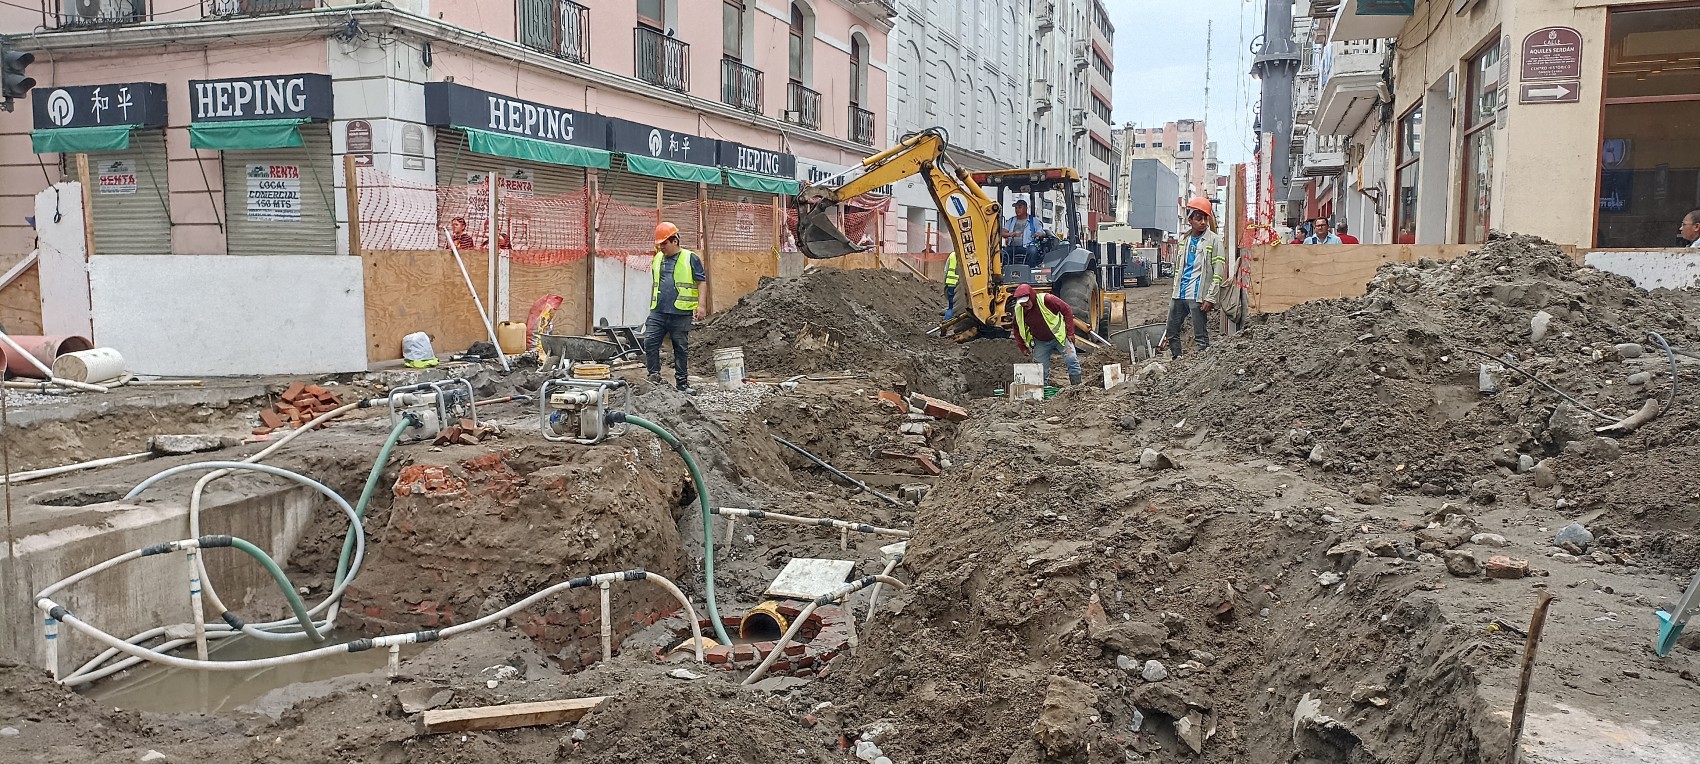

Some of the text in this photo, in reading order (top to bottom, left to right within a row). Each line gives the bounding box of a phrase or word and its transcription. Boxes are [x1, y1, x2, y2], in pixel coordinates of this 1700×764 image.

[195, 78, 307, 118] HEPING
[91, 87, 133, 124] 和平
[488, 96, 575, 141] HEPING
[668, 133, 691, 160] 和平
[737, 146, 780, 174] HEPING
[269, 165, 299, 179] RENTA
[99, 174, 136, 186] RENTA
[259, 181, 287, 190] LOCAL
[505, 180, 533, 192] RENTA
[249, 190, 299, 200] COMERCIAL
[273, 200, 292, 209] MTS
